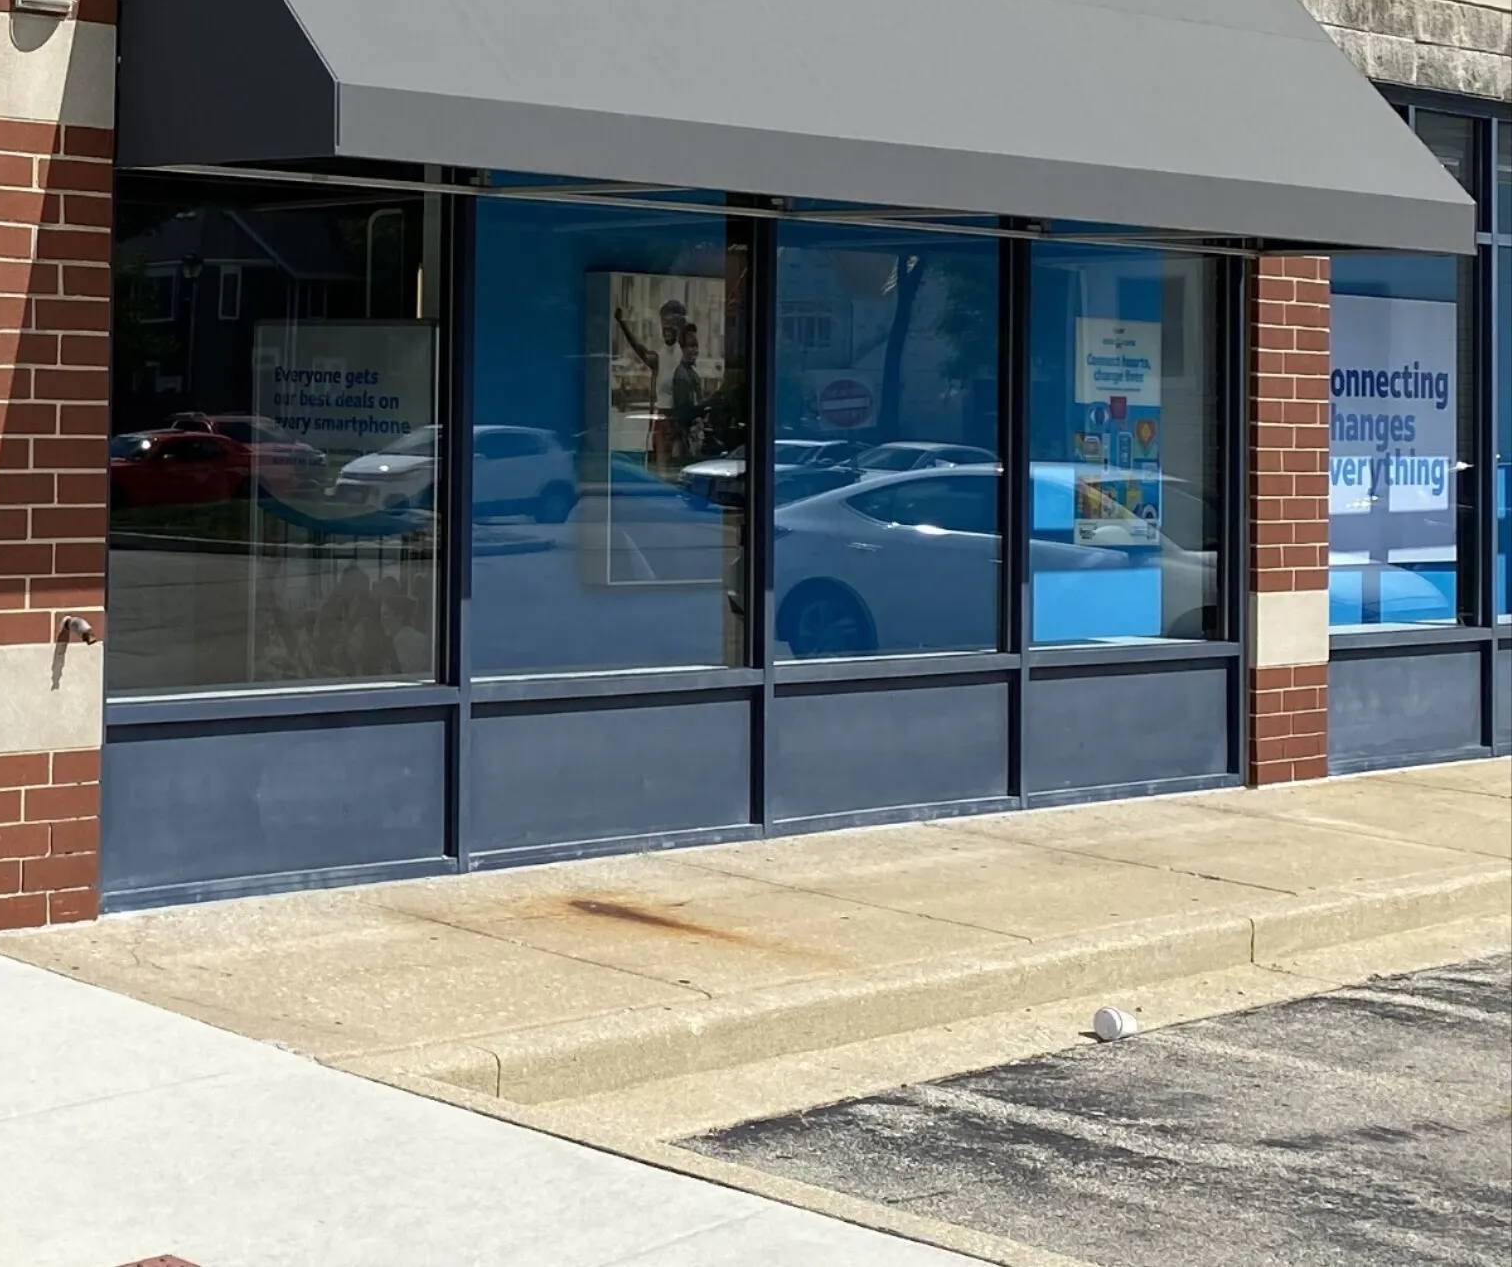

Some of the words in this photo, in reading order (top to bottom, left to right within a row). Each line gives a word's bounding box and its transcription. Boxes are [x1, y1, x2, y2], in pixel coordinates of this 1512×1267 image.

[274, 366, 341, 387] Everyone
[345, 368, 379, 389] gets
[299, 390, 331, 407] best
[335, 390, 375, 409] deals
[379, 396, 399, 410] on
[314, 415, 412, 436] smartphone
